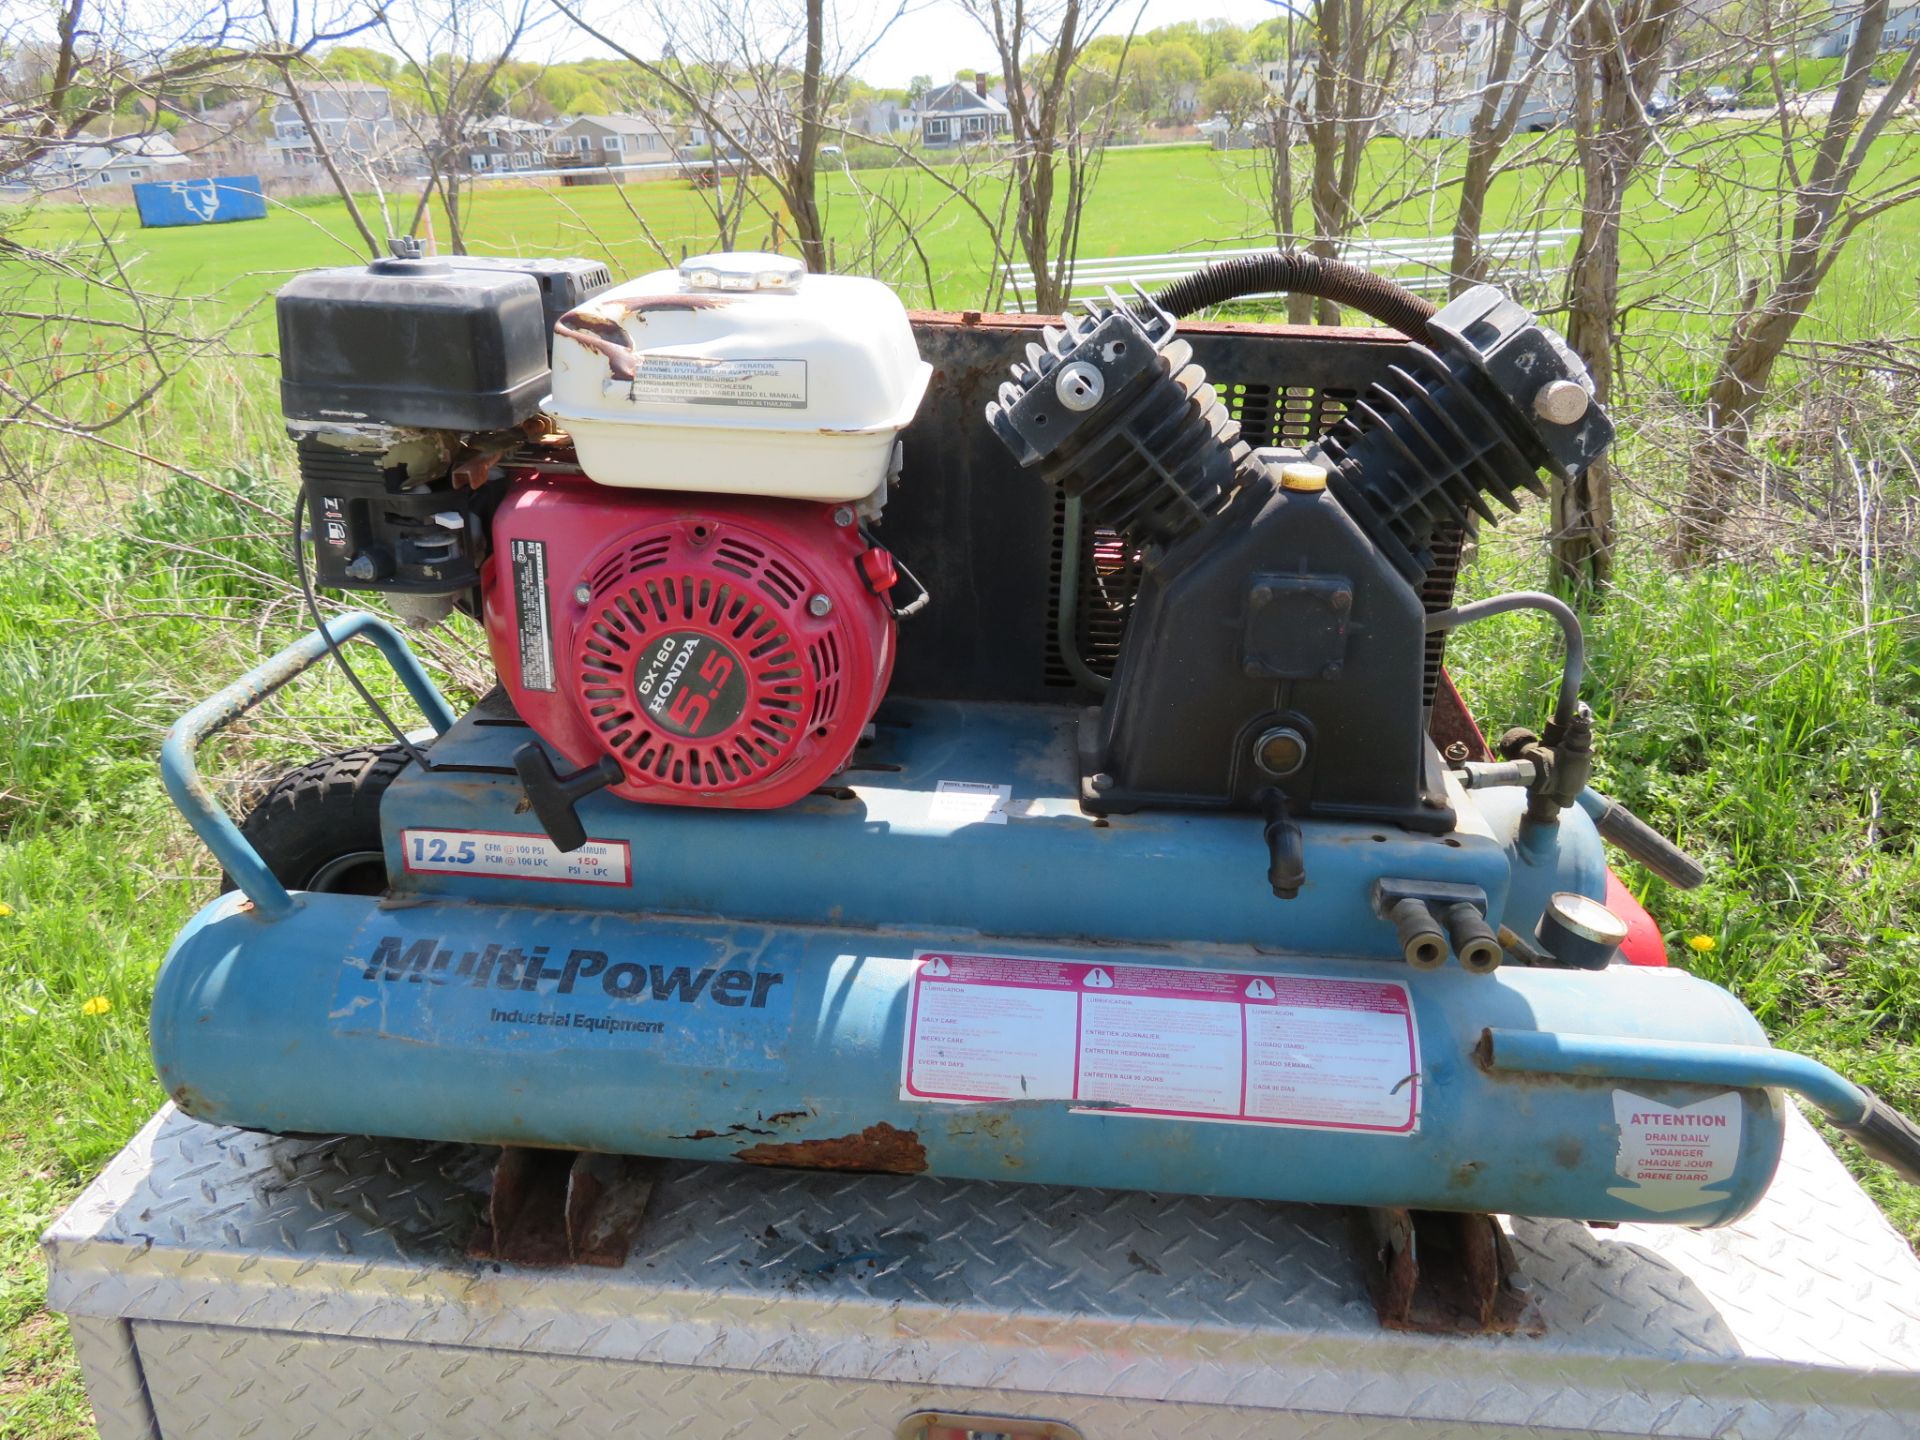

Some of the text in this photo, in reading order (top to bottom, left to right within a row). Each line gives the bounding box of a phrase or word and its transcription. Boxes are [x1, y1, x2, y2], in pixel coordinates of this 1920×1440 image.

[638, 637, 676, 695] GX160
[648, 639, 701, 714] HONDA
[667, 649, 734, 734] 5.5
[413, 838, 476, 864] 12.5
[484, 842, 502, 852] CFM
[516, 846, 530, 855] 100
[532, 847, 545, 855] PSI
[572, 846, 608, 856] XIMUM
[485, 855, 503, 864] PCM
[517, 857, 532, 866] 100
[534, 858, 549, 867] LPC
[577, 857, 598, 866] 150
[568, 866, 581, 875] PSI
[593, 868, 608, 877] LPC
[362, 936, 784, 1008] Multi-Power
[490, 1007, 665, 1035] Industrial Equipment
[1630, 1113, 1726, 1127] ATTENTION
[1645, 1132, 1710, 1143] DRAIN DAILY
[1650, 1148, 1704, 1157] VIDANGER
[1638, 1159, 1713, 1168] CHAQUE JOUR
[1637, 1172, 1673, 1180] DRENE
